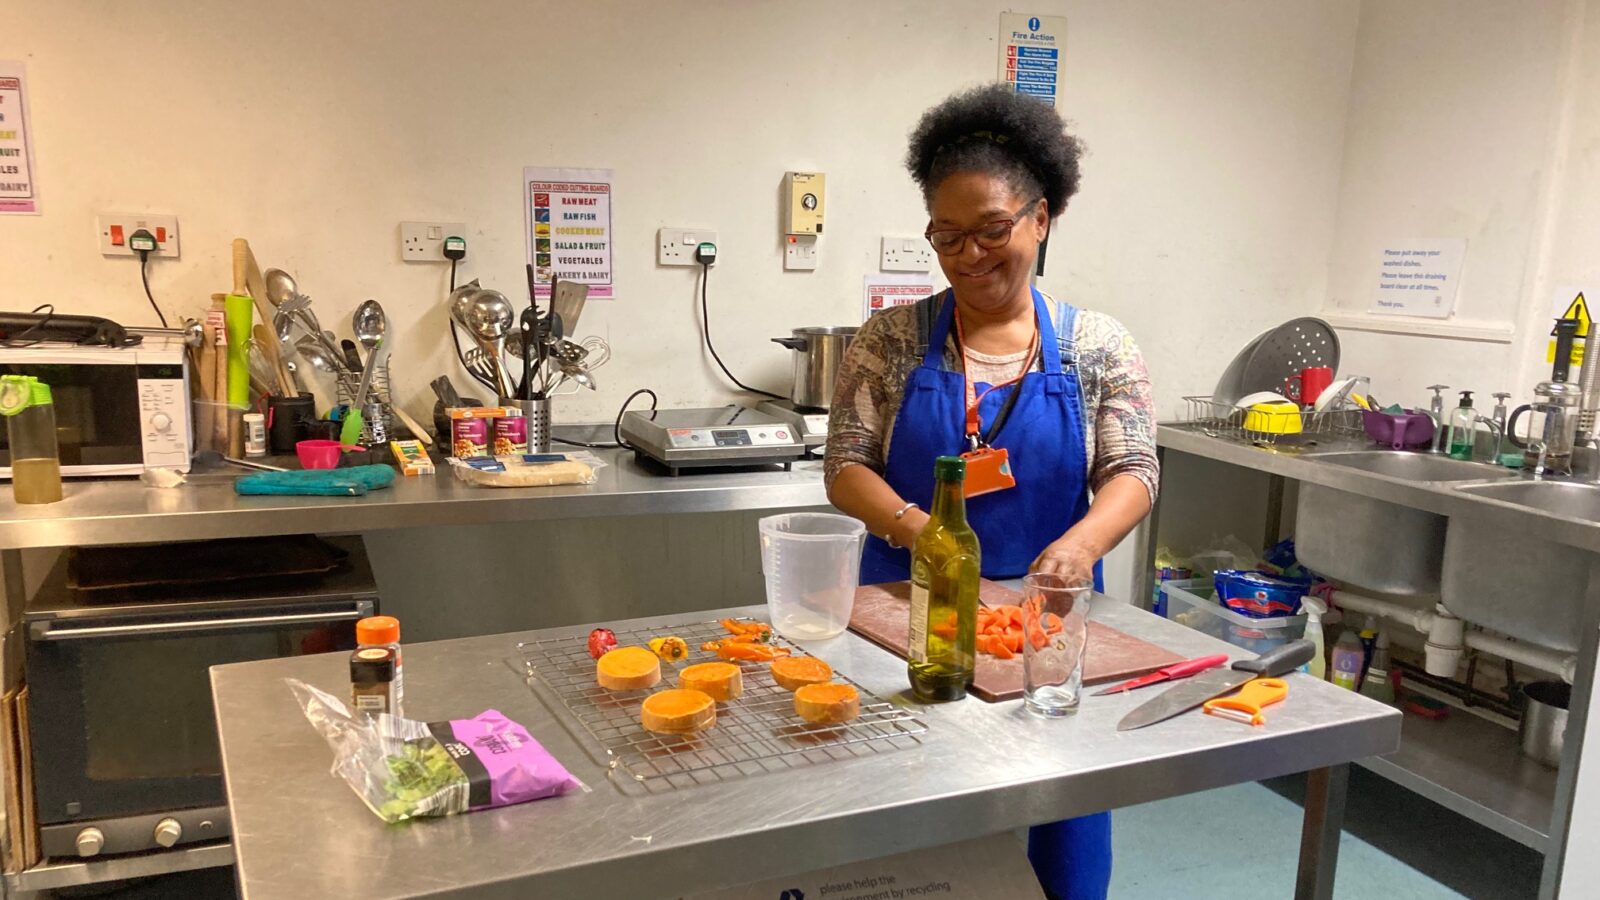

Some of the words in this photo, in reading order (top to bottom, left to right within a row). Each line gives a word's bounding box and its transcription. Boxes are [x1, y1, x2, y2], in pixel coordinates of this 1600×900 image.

[820, 882, 852, 896] please
[854, 879, 877, 891] help
[878, 874, 896, 885] the
[890, 888, 905, 899] by
